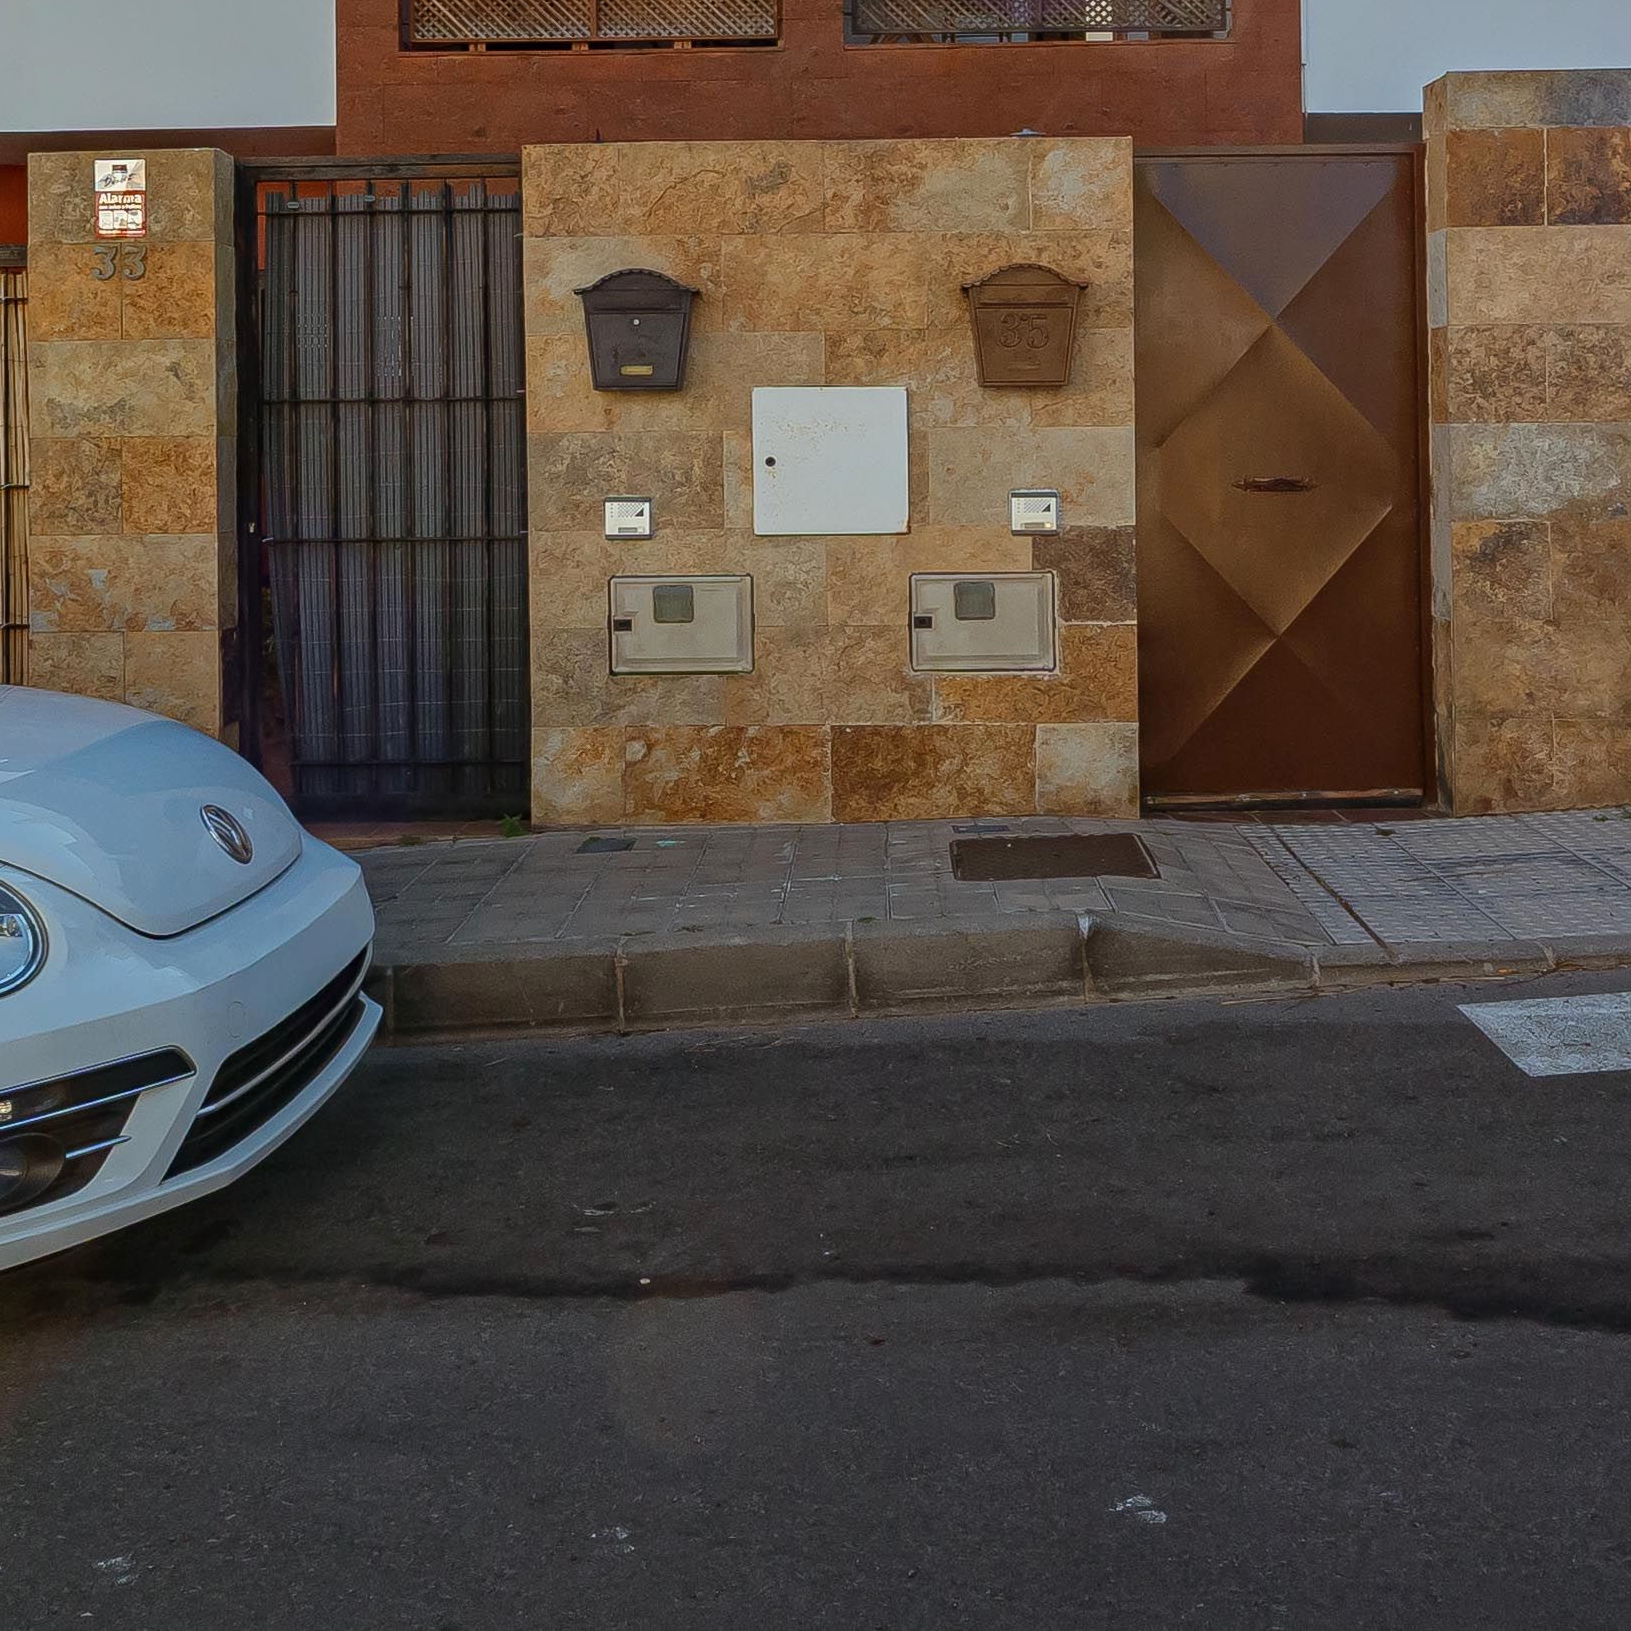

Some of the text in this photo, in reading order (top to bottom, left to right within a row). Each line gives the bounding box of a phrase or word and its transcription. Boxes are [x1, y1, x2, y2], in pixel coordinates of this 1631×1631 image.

[99, 192, 143, 204] Alarma
[92, 245, 147, 281] 33
[999, 312, 1050, 349] 35
